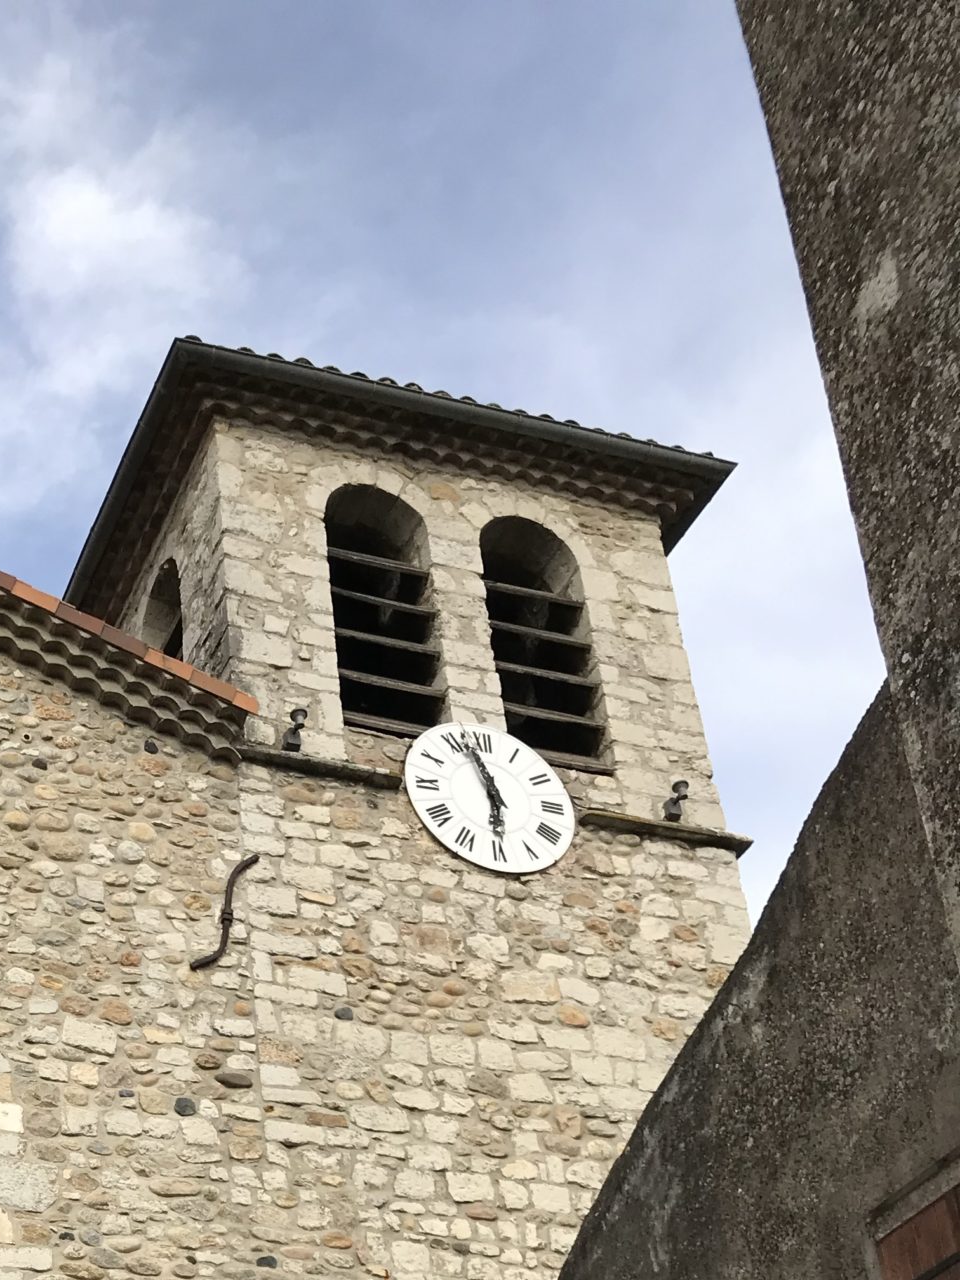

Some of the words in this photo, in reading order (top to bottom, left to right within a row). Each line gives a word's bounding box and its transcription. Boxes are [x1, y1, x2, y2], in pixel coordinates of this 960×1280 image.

[472, 731, 492, 753] XII
[420, 749, 445, 767] X
[415, 775, 440, 791] IX
[529, 773, 551, 786] II
[426, 803, 454, 828] VIII
[541, 800, 564, 815] III
[455, 827, 475, 852] VII
[536, 822, 562, 845] IIII
[492, 840, 508, 862] VI
[522, 840, 539, 861] V
